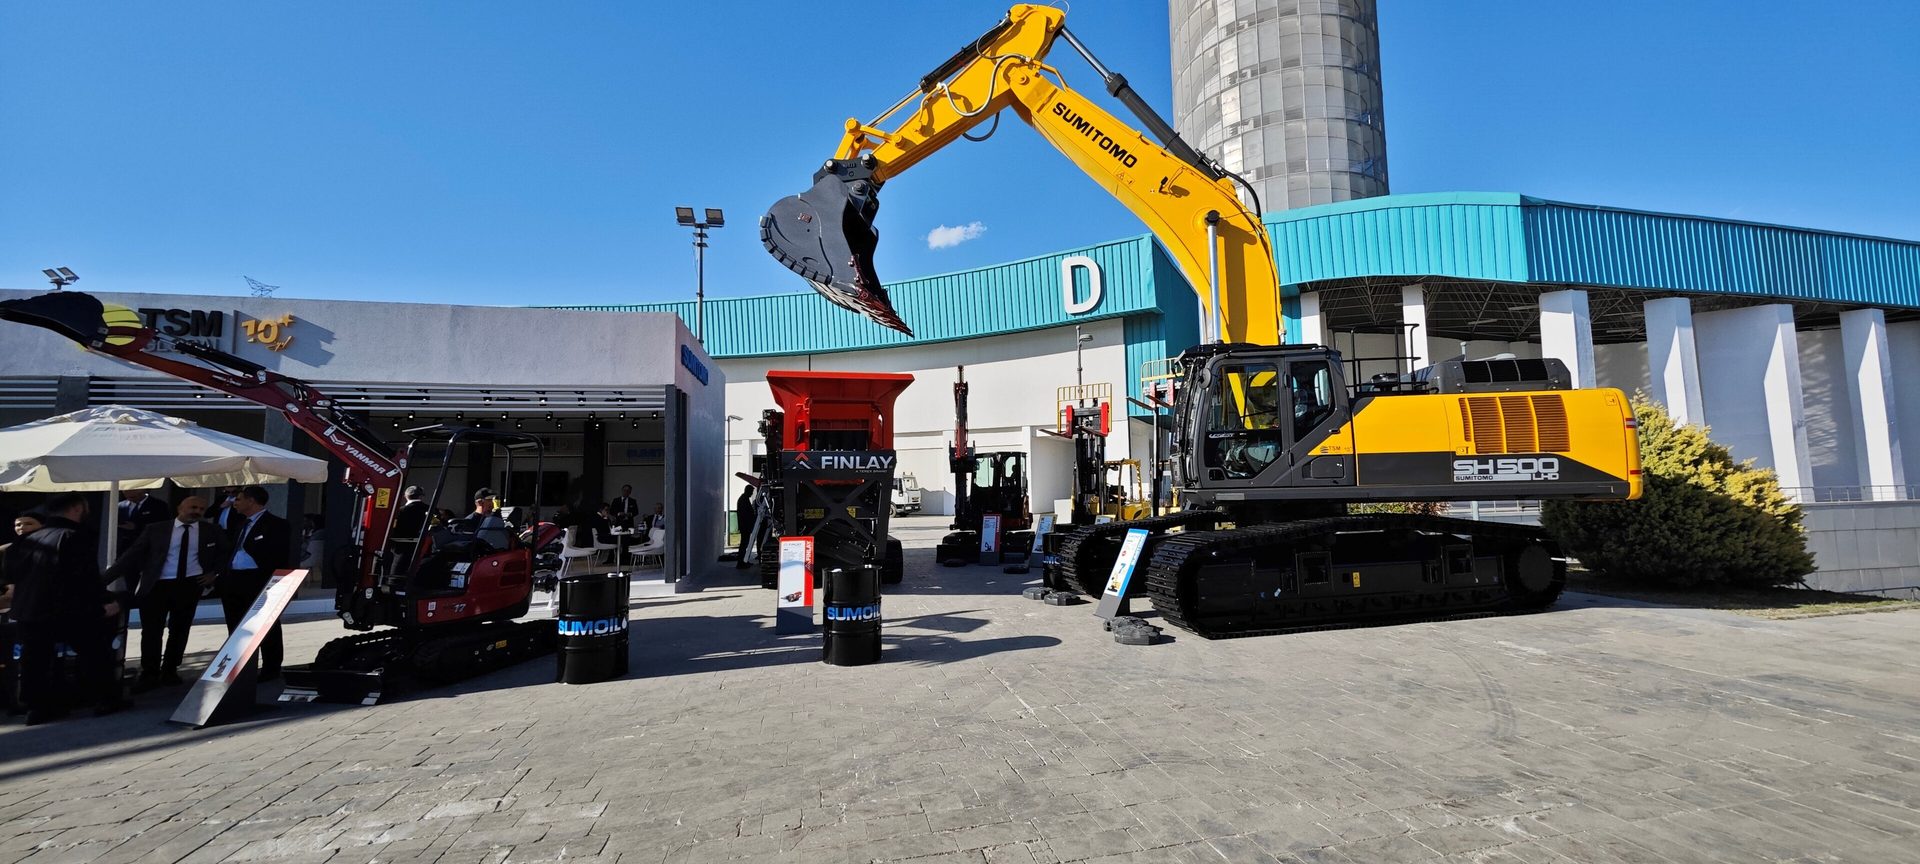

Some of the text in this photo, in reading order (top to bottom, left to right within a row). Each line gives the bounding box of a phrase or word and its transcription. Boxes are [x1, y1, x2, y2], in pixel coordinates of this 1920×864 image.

[1052, 102, 1138, 168] SUMITOMO
[1061, 255, 1102, 315] D
[138, 308, 224, 338] TSM
[345, 444, 386, 474] YANMAR
[821, 455, 893, 470] FINLAY
[1532, 472, 1559, 481] LHD
[827, 604, 881, 621] SUMOIL
[558, 617, 621, 636] SUMOIL
